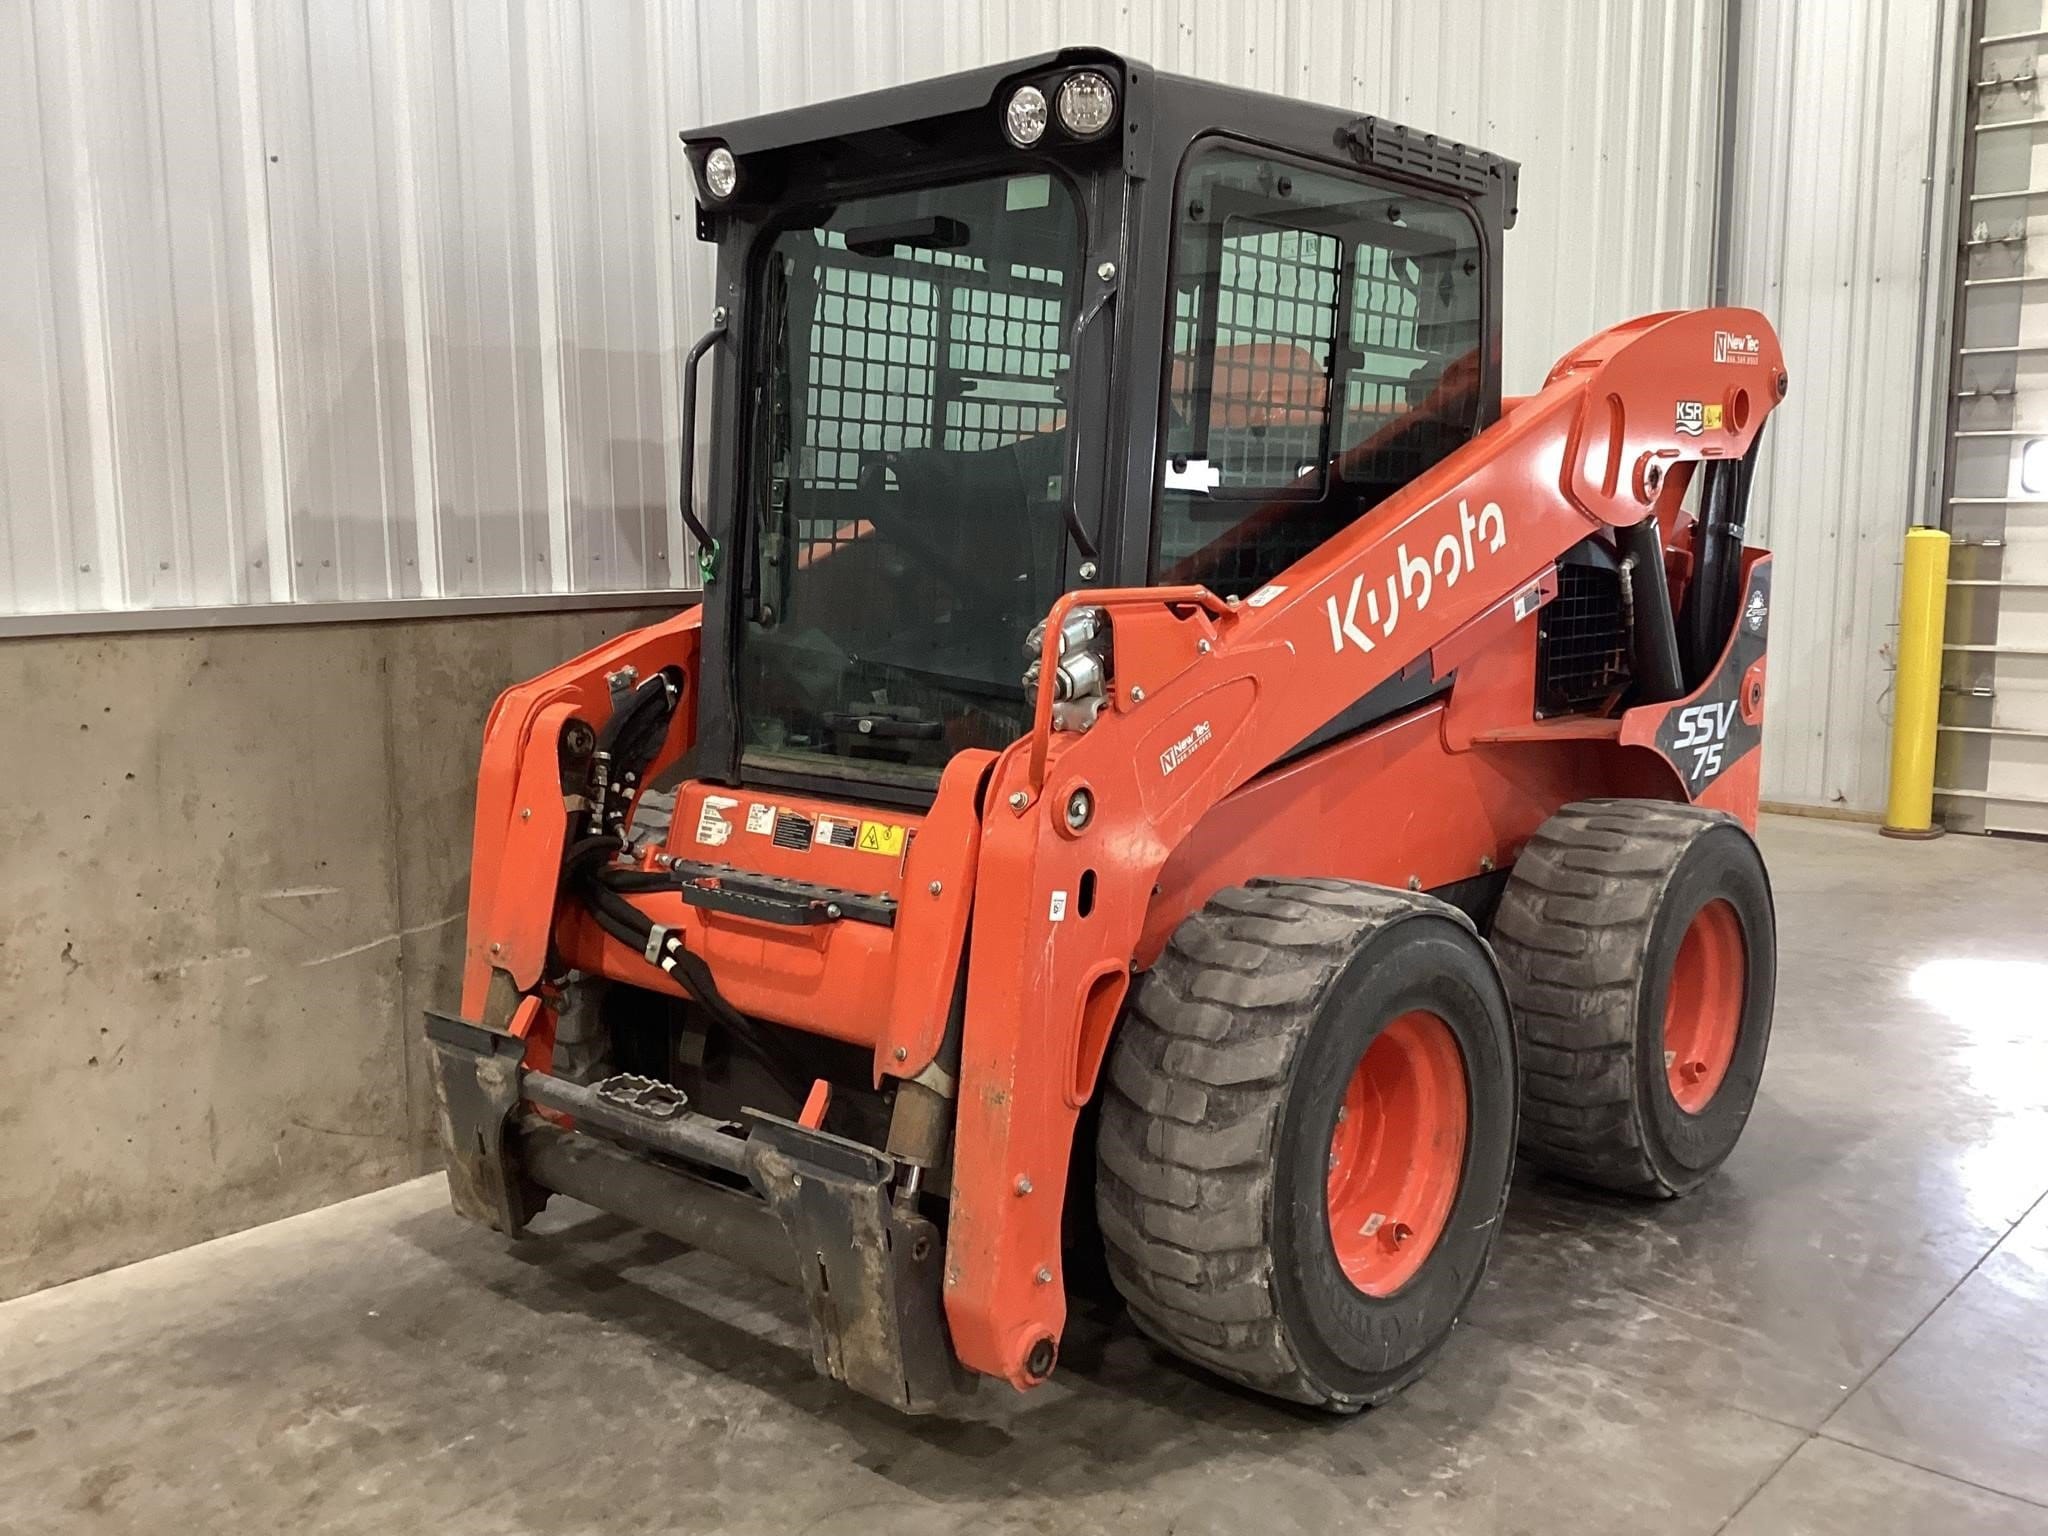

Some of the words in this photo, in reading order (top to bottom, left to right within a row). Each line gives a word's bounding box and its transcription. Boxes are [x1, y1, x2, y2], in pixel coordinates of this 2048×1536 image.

[1727, 332, 1745, 351] New
[1745, 334, 1760, 352] Tec
[1676, 401, 1703, 420] KSR
[1326, 498, 1507, 653] Kubota
[1174, 733, 1194, 755] New
[1193, 720, 1210, 737] Tec
[1673, 699, 1738, 750] SSV
[1691, 743, 1724, 780] 75
